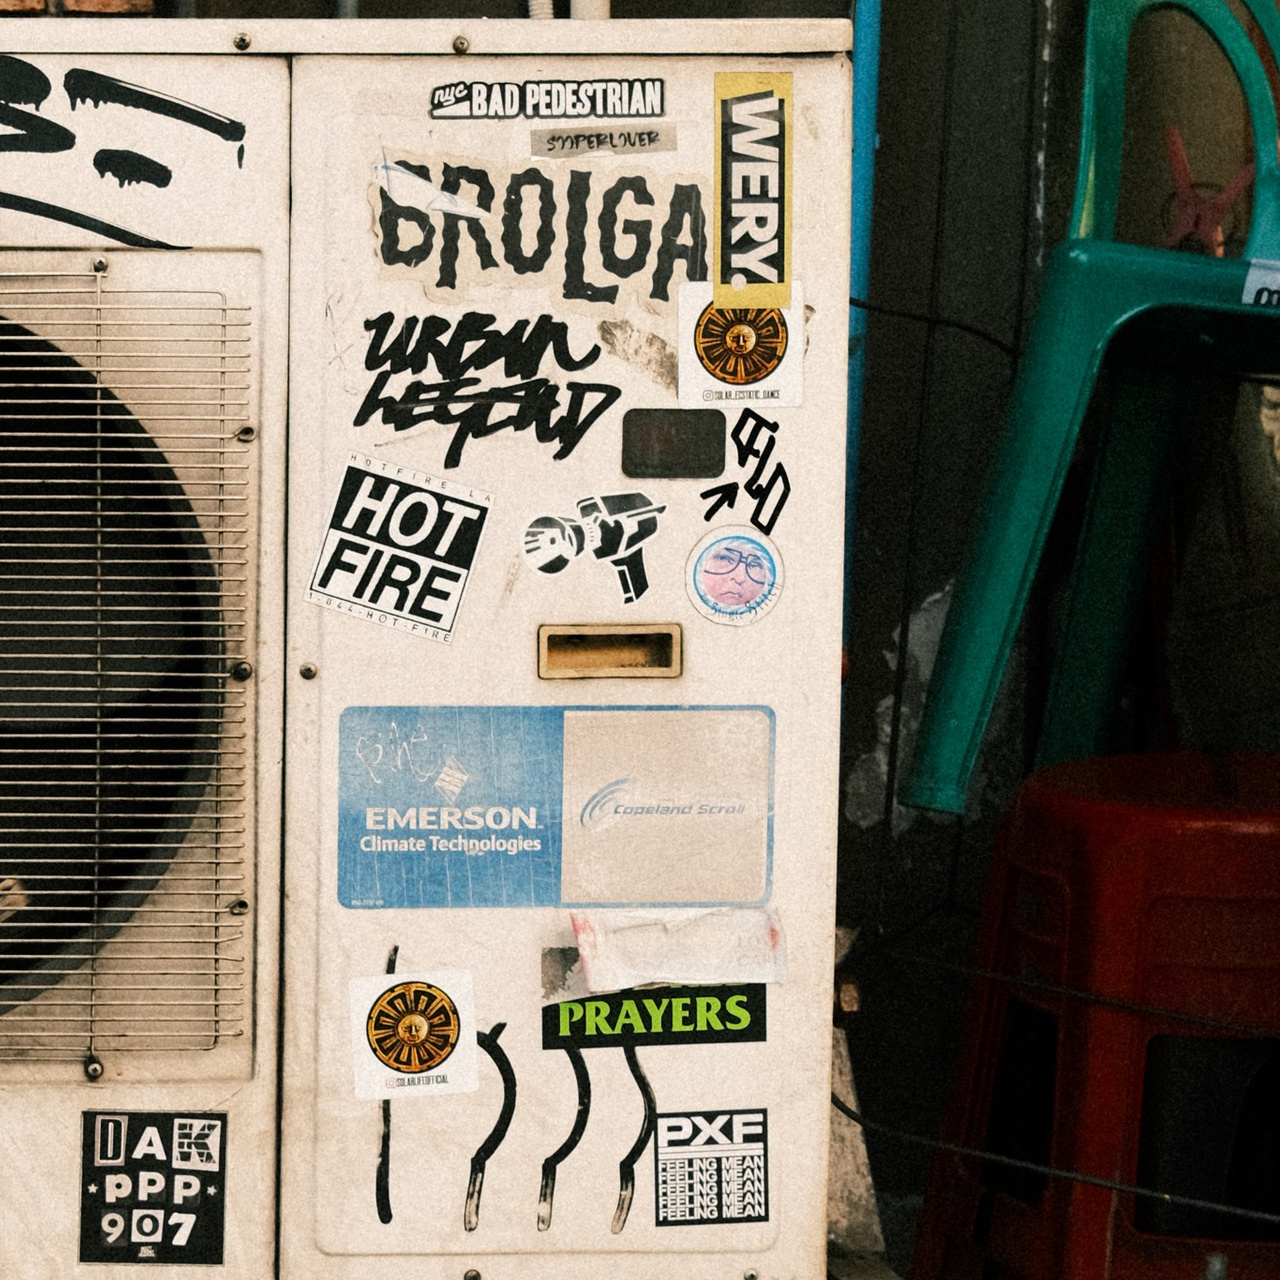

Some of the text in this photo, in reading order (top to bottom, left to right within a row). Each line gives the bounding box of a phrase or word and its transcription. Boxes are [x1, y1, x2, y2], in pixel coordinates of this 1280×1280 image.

[471, 82, 520, 117] BAD
[525, 81, 661, 116] PEDESTRIAN
[341, 476, 480, 557] HOT
[318, 538, 461, 622] FIRE
[366, 806, 538, 830] EMERSON
[613, 803, 746, 817] Copeland Scroll
[360, 834, 542, 855] Climate Technologies
[558, 995, 752, 1037] PRAYERS
[97, 1116, 220, 1169] DAK
[659, 1155, 764, 1172] FEELING MEAN
[659, 1167, 764, 1184] FEELING MEAN
[659, 1179, 764, 1196] FEELING MEAN
[660, 1191, 765, 1208] FEELING MEAN
[660, 1203, 765, 1220] FEELING MEAN
[101, 1211, 197, 1246] 907
